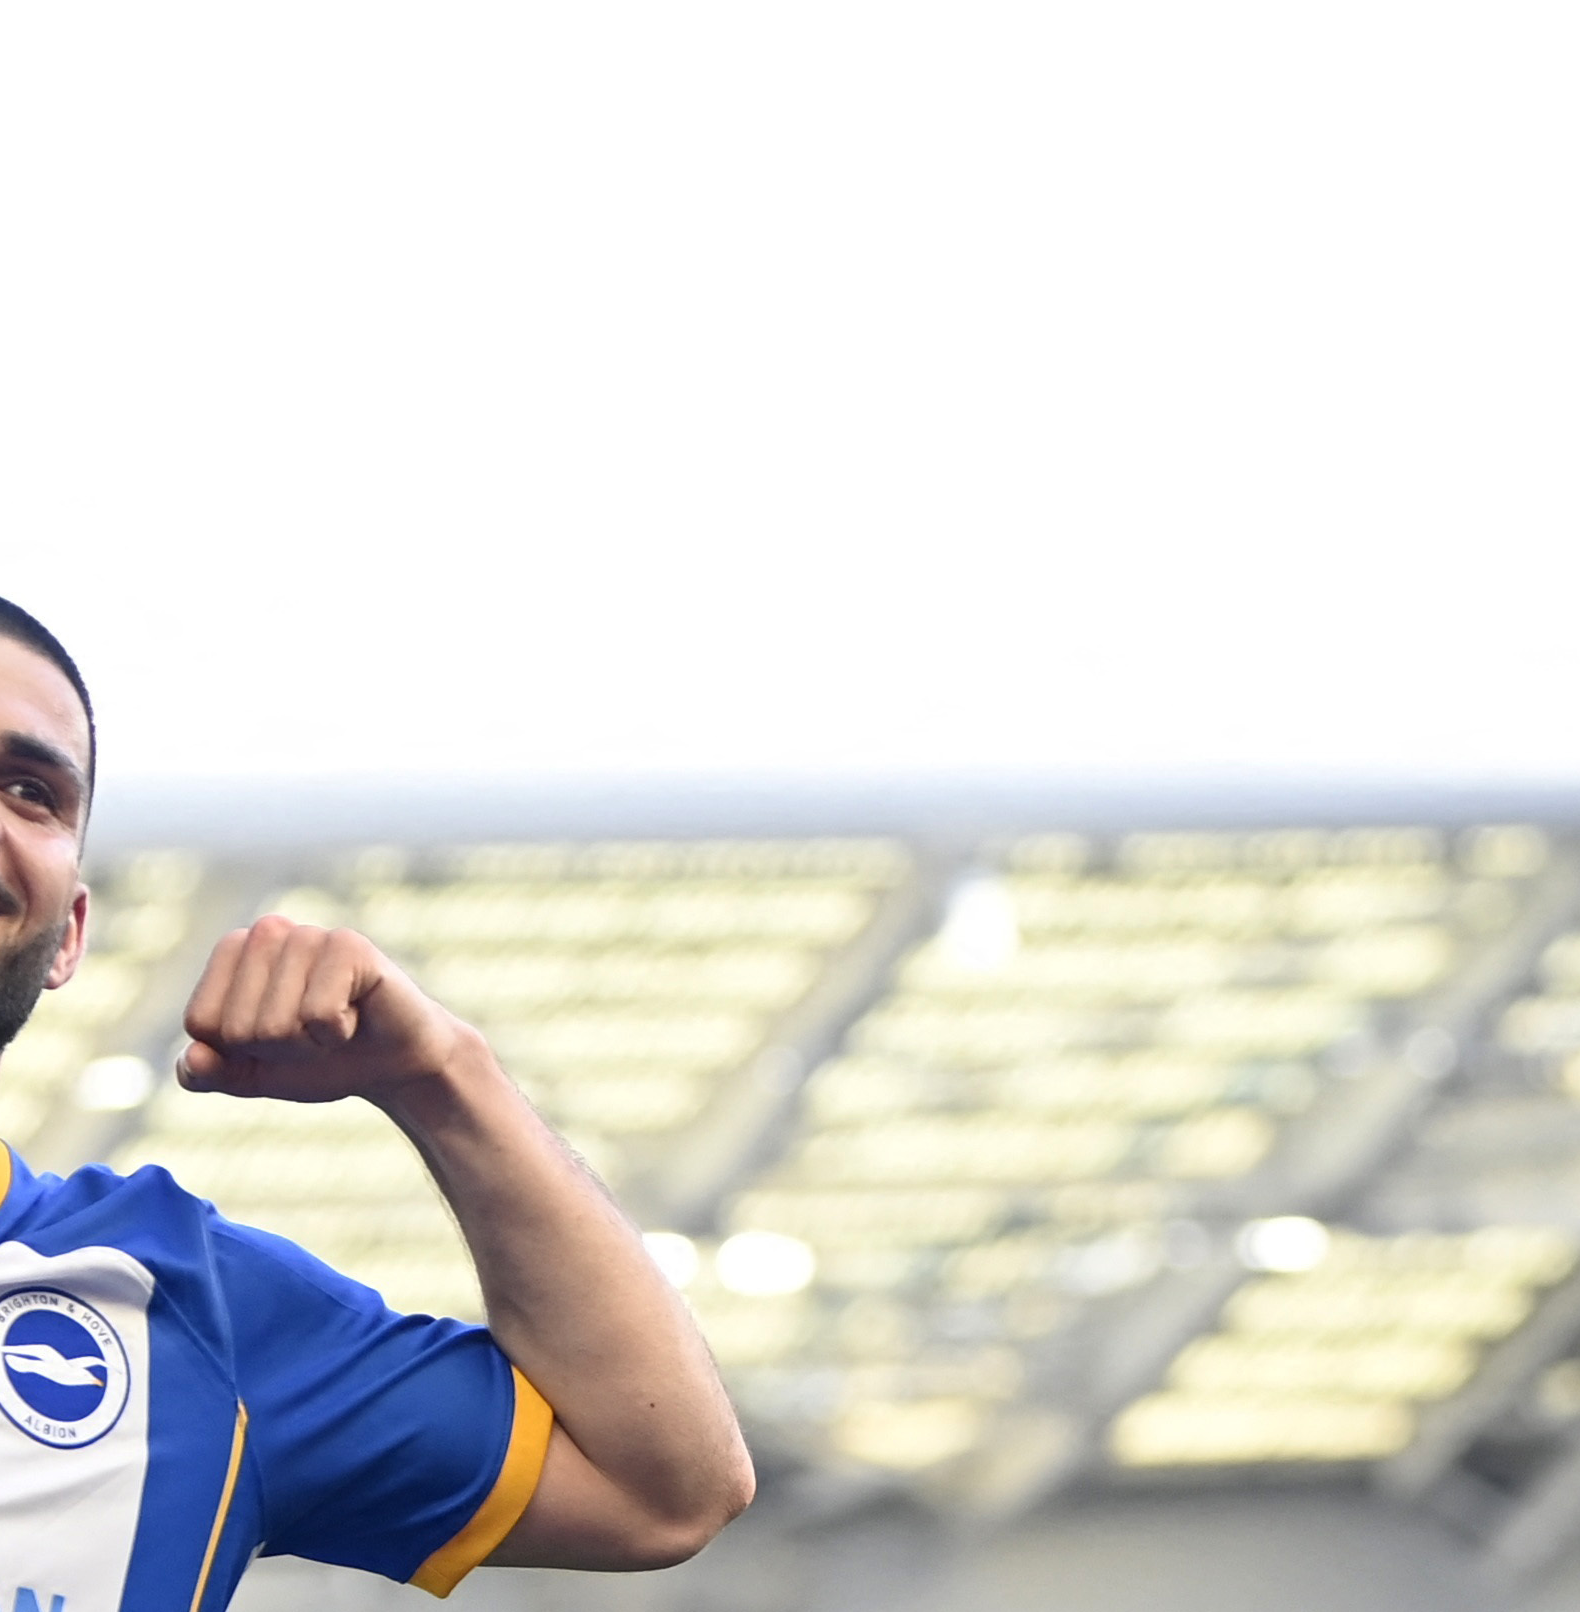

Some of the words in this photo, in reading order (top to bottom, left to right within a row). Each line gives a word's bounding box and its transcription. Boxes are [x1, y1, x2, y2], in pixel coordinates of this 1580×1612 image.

[66, 1303, 76, 1314] &
[81, 1311, 114, 1347] HOVE
[24, 1415, 77, 1439] ALBION
